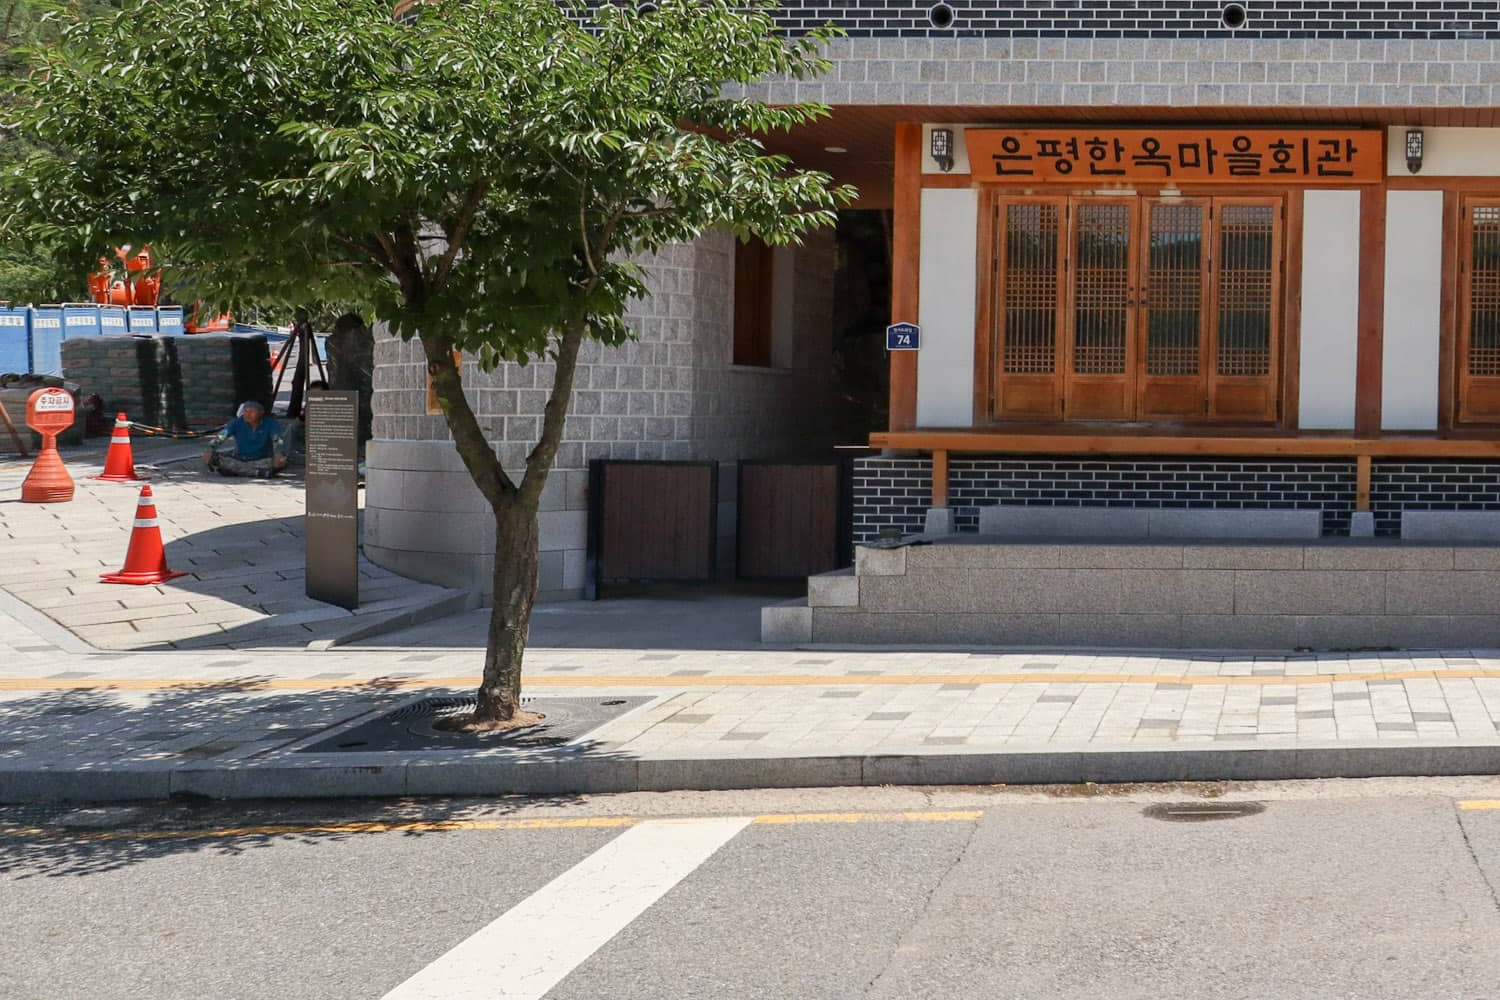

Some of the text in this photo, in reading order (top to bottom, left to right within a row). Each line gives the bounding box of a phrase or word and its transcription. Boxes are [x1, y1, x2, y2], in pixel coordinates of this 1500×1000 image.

[992, 135, 1358, 177] 은평한옥마을회관
[897, 334, 910, 345] 74
[40, 396, 70, 404] 주차금지
